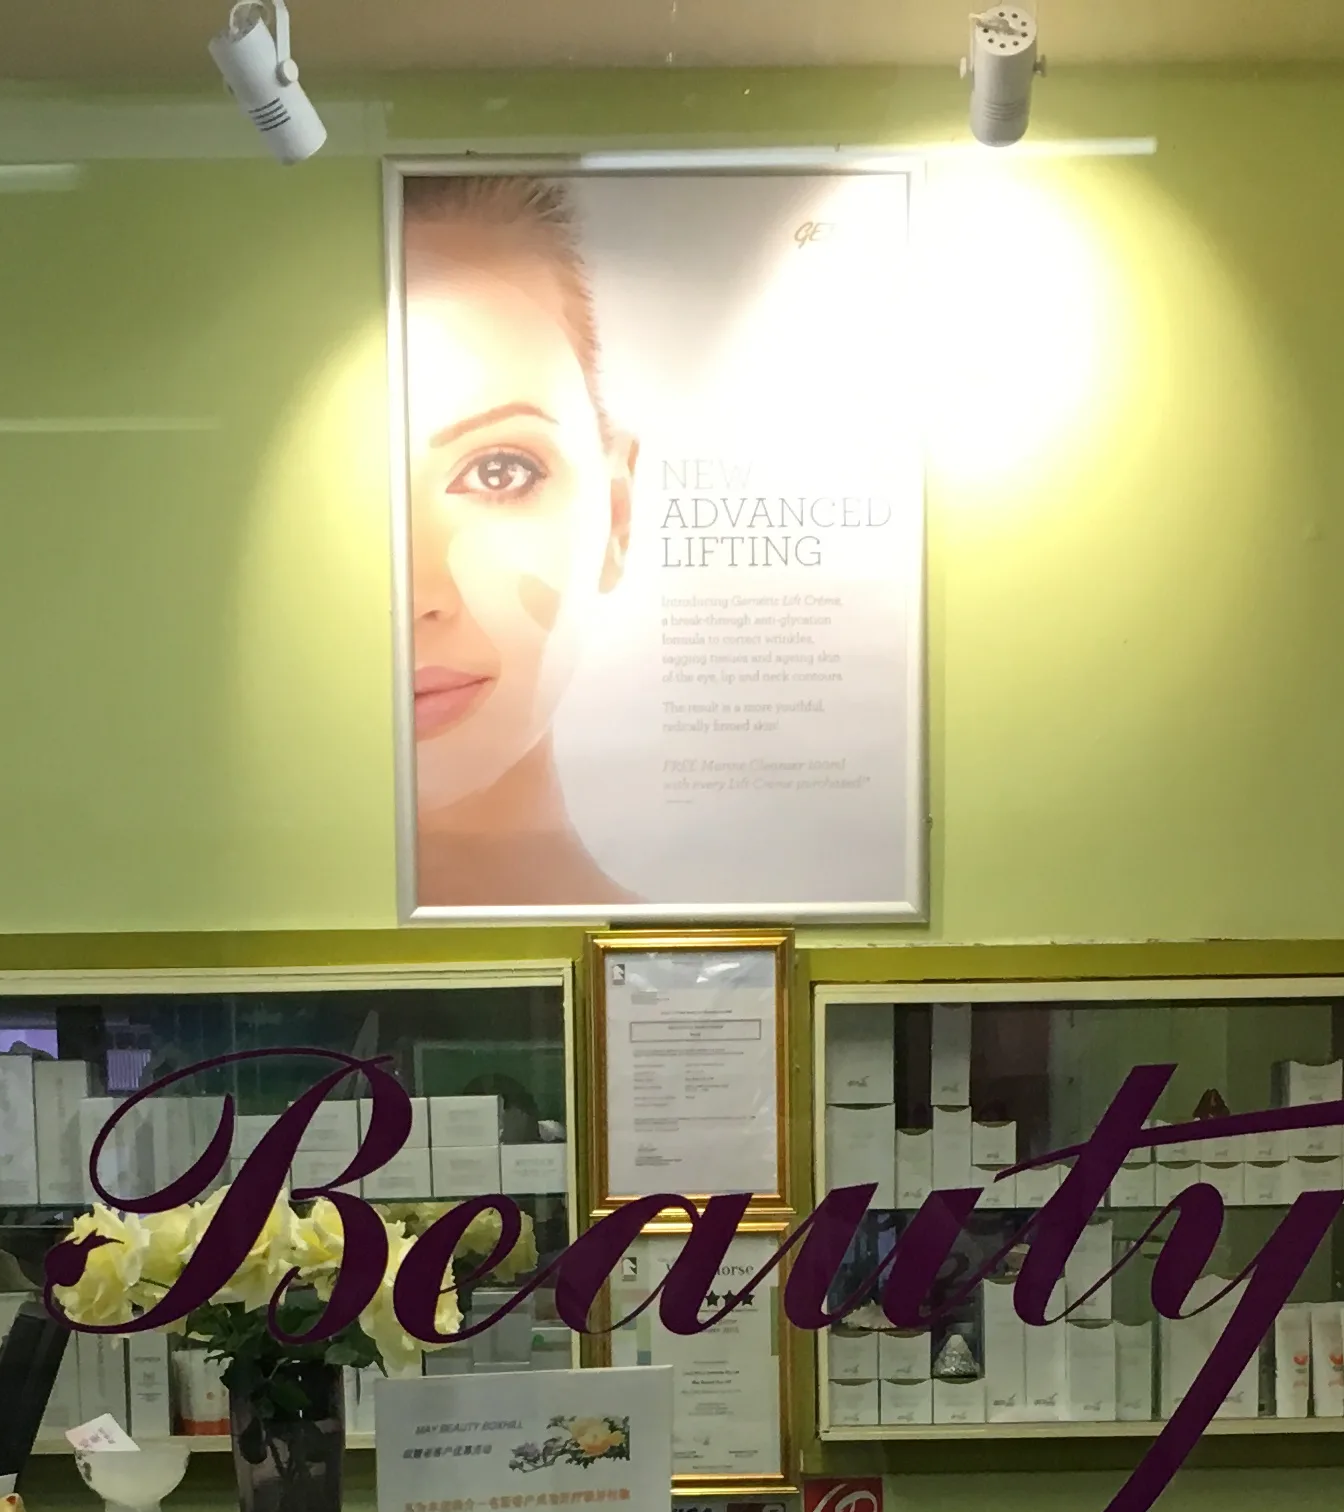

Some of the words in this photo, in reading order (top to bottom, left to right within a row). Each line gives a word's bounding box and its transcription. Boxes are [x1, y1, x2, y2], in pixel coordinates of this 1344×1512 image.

[660, 459, 753, 491] NEW
[660, 497, 892, 529] ADVANCED
[660, 535, 822, 568] LIFTING
